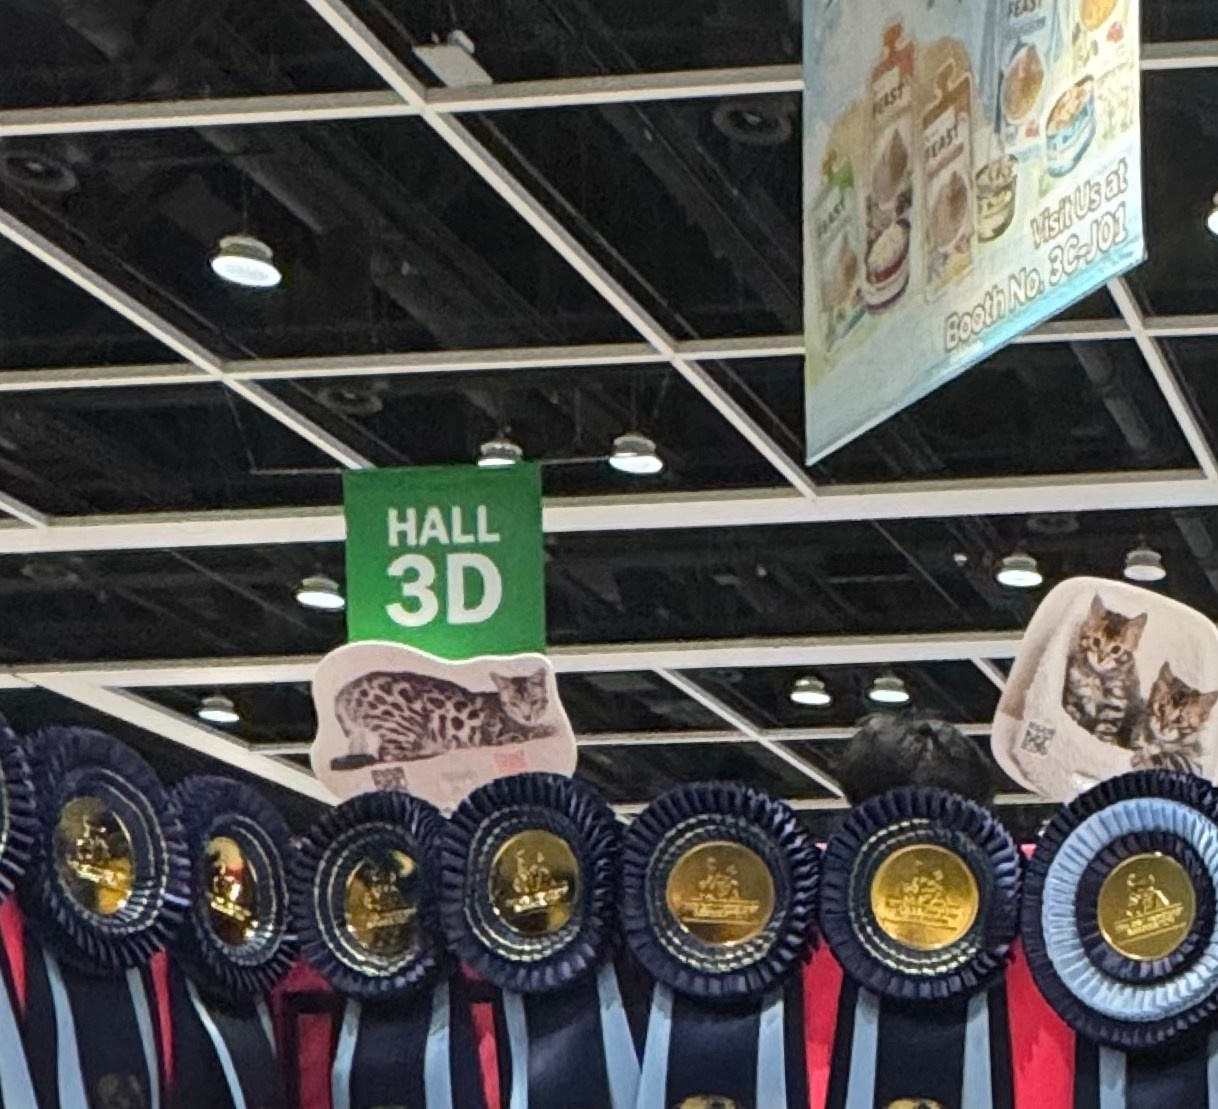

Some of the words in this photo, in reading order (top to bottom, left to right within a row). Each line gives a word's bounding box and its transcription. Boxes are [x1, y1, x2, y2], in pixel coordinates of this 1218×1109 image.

[1030, 197, 1073, 249] Visit
[1071, 179, 1102, 220] Us
[1104, 156, 1128, 202] at
[945, 285, 1006, 351] Booth
[1008, 266, 1045, 313] No.
[1048, 200, 1128, 286] 3C-J01
[387, 504, 501, 547] HALL
[385, 552, 503, 628] 3D
